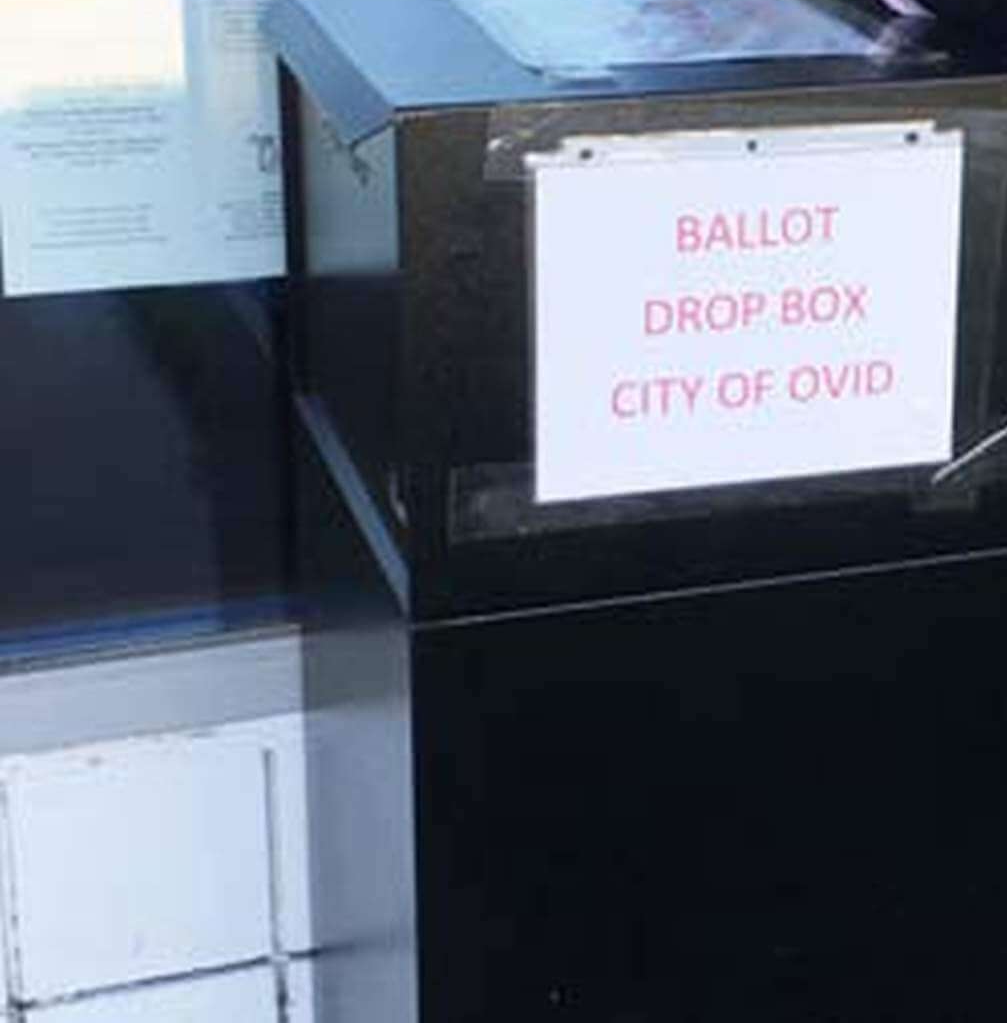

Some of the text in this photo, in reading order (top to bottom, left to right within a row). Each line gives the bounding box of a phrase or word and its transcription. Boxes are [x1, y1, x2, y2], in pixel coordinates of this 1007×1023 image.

[675, 205, 840, 253] BALLOT
[644, 284, 868, 336] DROP BOX
[611, 360, 895, 418] CITY OF OVID
